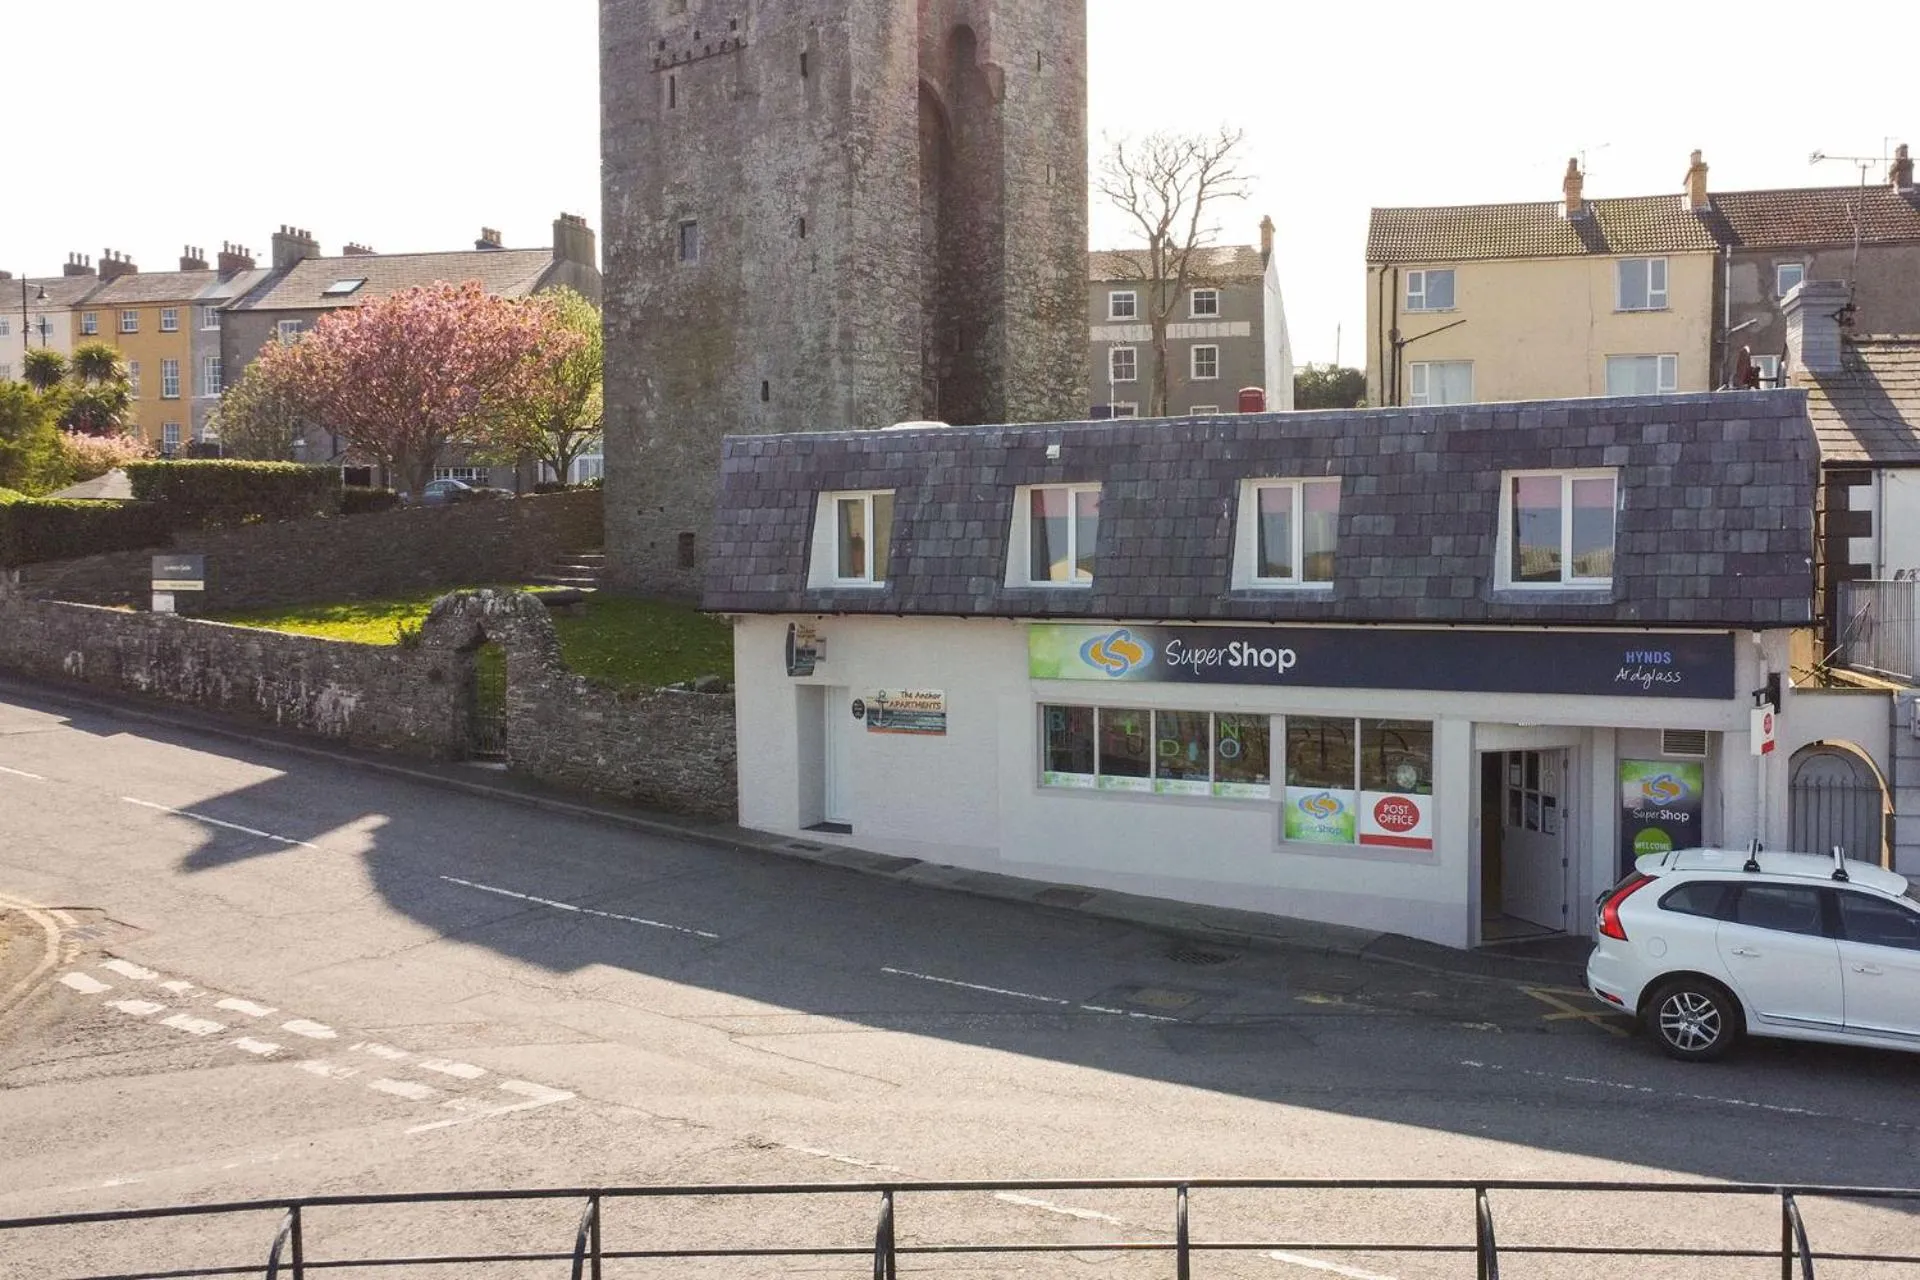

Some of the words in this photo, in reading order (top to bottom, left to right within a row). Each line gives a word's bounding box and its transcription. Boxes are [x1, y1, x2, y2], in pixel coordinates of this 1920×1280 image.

[1165, 639, 1297, 675] SuperShop
[1625, 651, 1671, 664] HYNDS
[1614, 666, 1681, 689] Ardglass
[901, 690, 912, 698] The
[889, 700, 942, 710] APARTMENTS
[1383, 804, 1409, 815] POST
[1632, 807, 1690, 823] SuperShop
[1377, 813, 1414, 826] OFFICE
[1635, 840, 1671, 851] WELCOME
